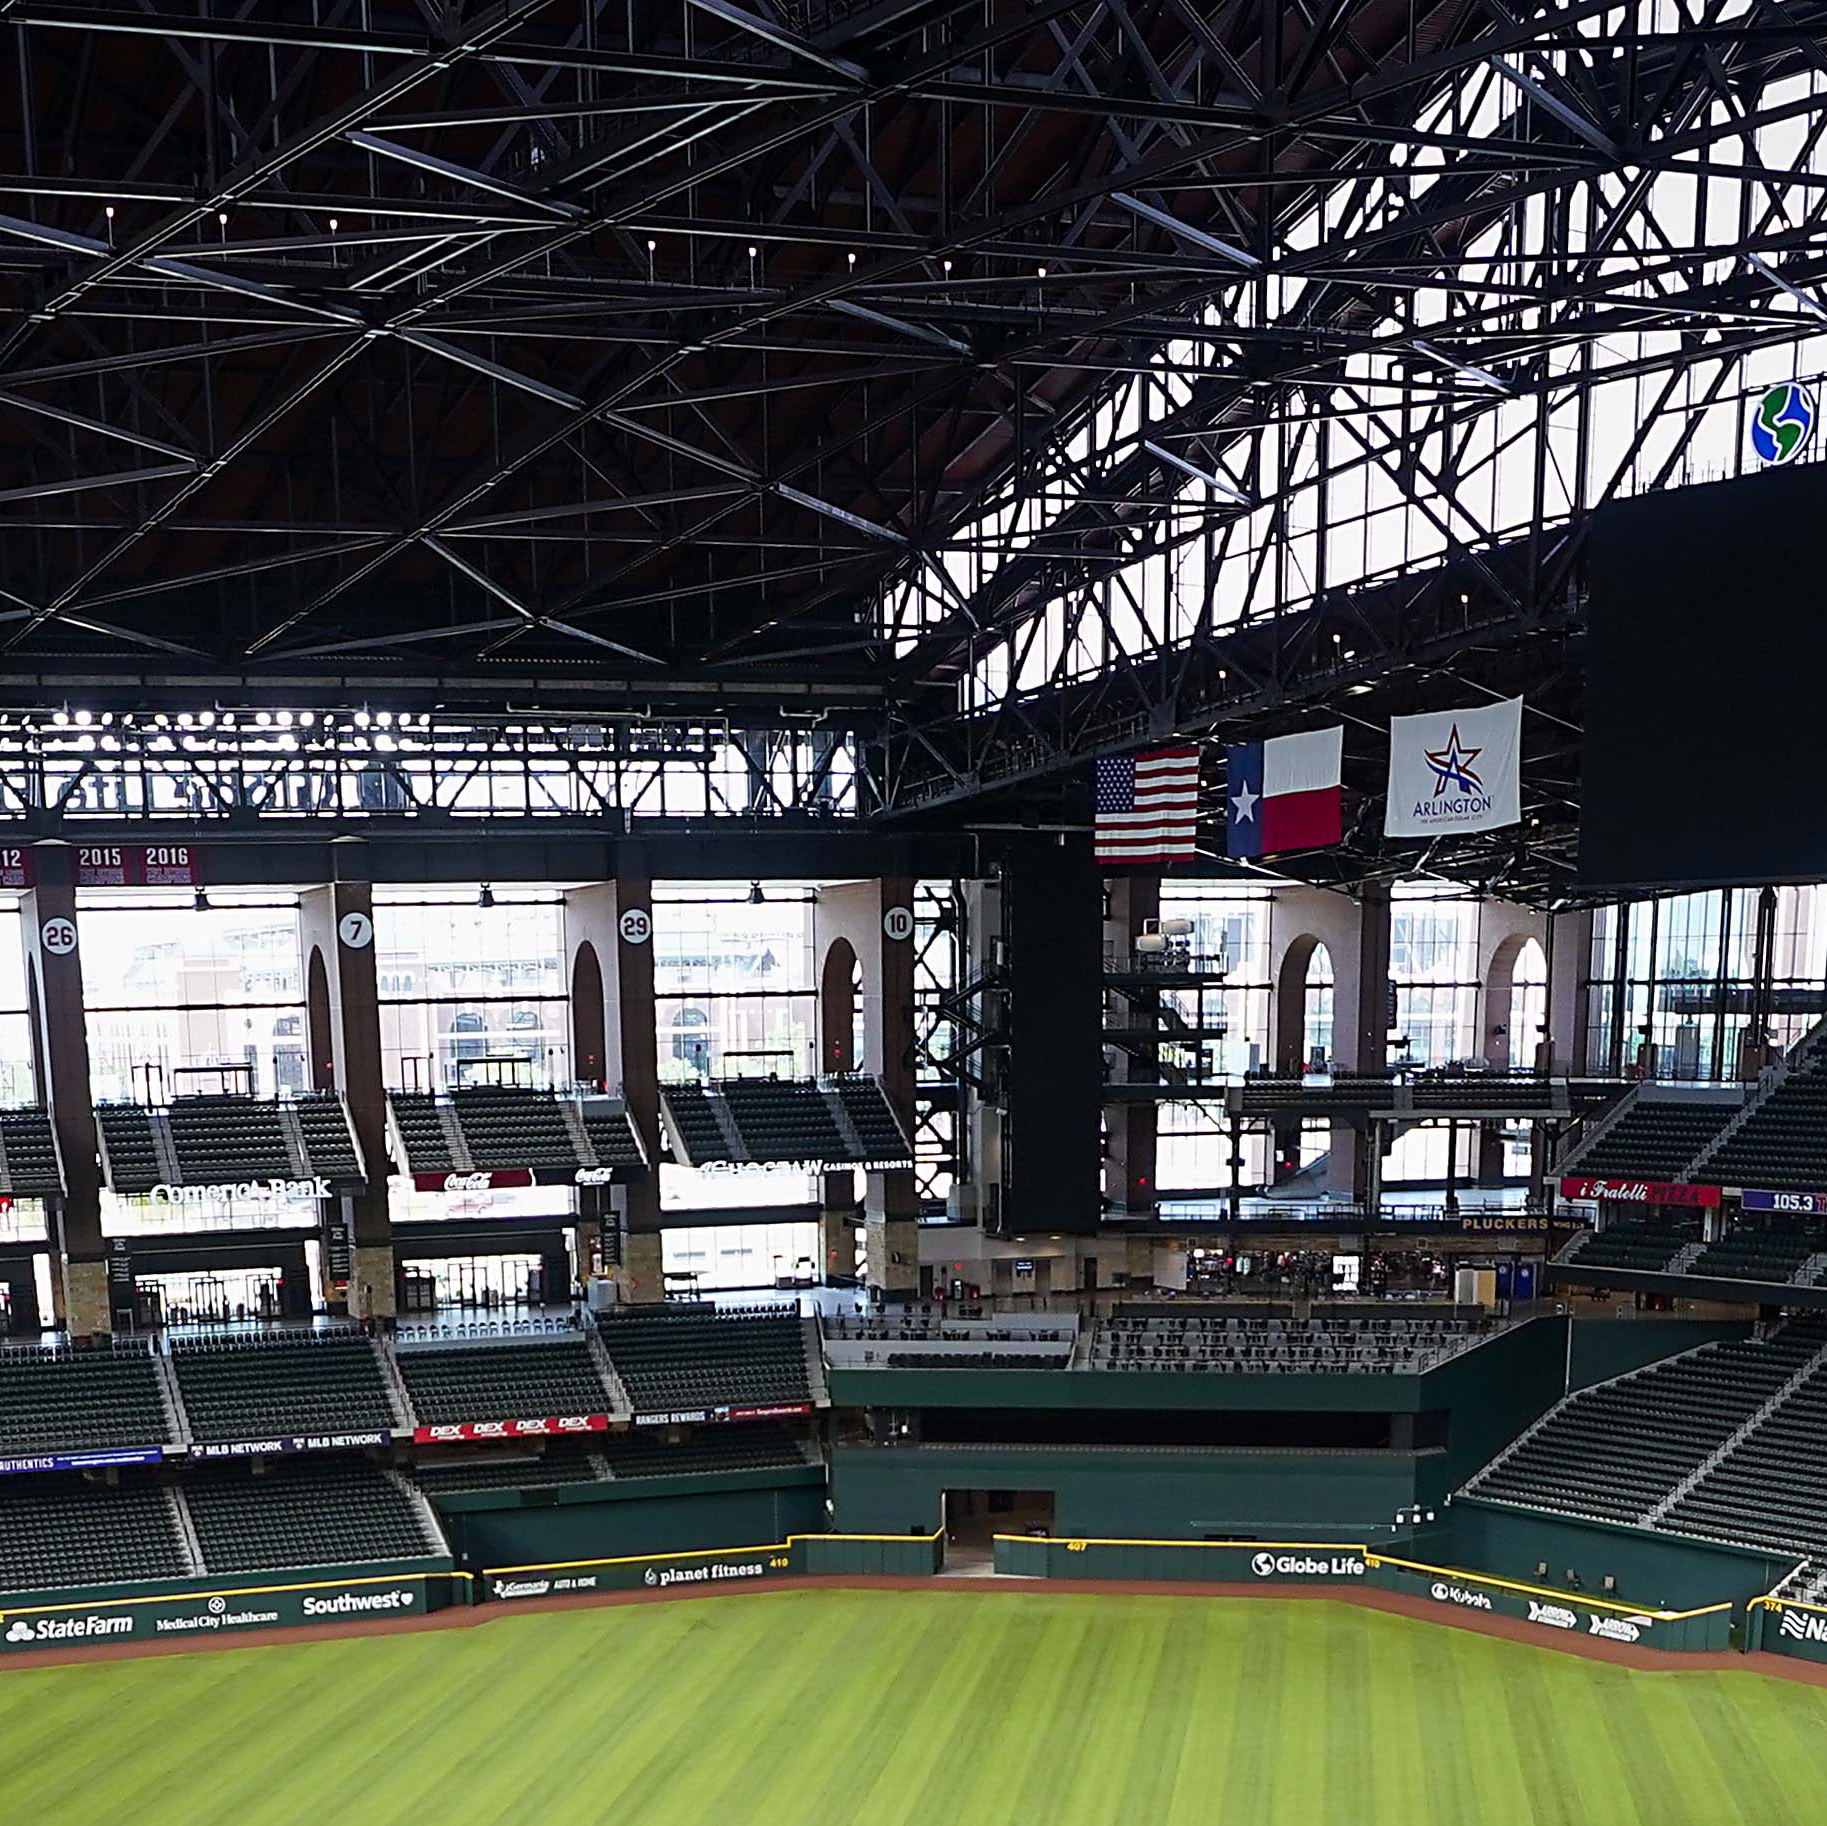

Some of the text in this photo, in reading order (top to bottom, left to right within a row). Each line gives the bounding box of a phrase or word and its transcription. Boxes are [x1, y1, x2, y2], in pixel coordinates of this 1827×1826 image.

[1413, 796, 1492, 817] ARLINGTON
[79, 848, 121, 867] 2015
[146, 847, 189, 866] 2016
[349, 921, 362, 940] 7
[624, 916, 649, 936] 29
[890, 914, 907, 933] 10
[47, 925, 73, 946] 26
[271, 1176, 332, 1200] Bank
[1590, 1180, 1649, 1201] Fratelli
[1773, 1194, 1813, 1211] 105.3
[1462, 1217, 1549, 1230] PLUCKERS
[516, 1420, 546, 1431] DEX
[559, 1417, 589, 1428] DEX
[635, 1410, 706, 1425] RANGERS REWARDS
[430, 1425, 461, 1437] DEX
[473, 1423, 504, 1435] DEX
[206, 1440, 283, 1456] MLB NETWORK
[307, 1433, 383, 1449] MLB NETWORK
[1067, 1542, 1087, 1552] 407
[770, 1557, 789, 1568] 410
[1276, 1556, 1364, 1576] Globe Life
[660, 1563, 763, 1586] planet fitness
[303, 1592, 400, 1616] Southwest
[1449, 1587, 1492, 1610] Kubota
[1763, 1601, 1783, 1613] 374
[157, 1610, 278, 1632] Medical City Healthcare
